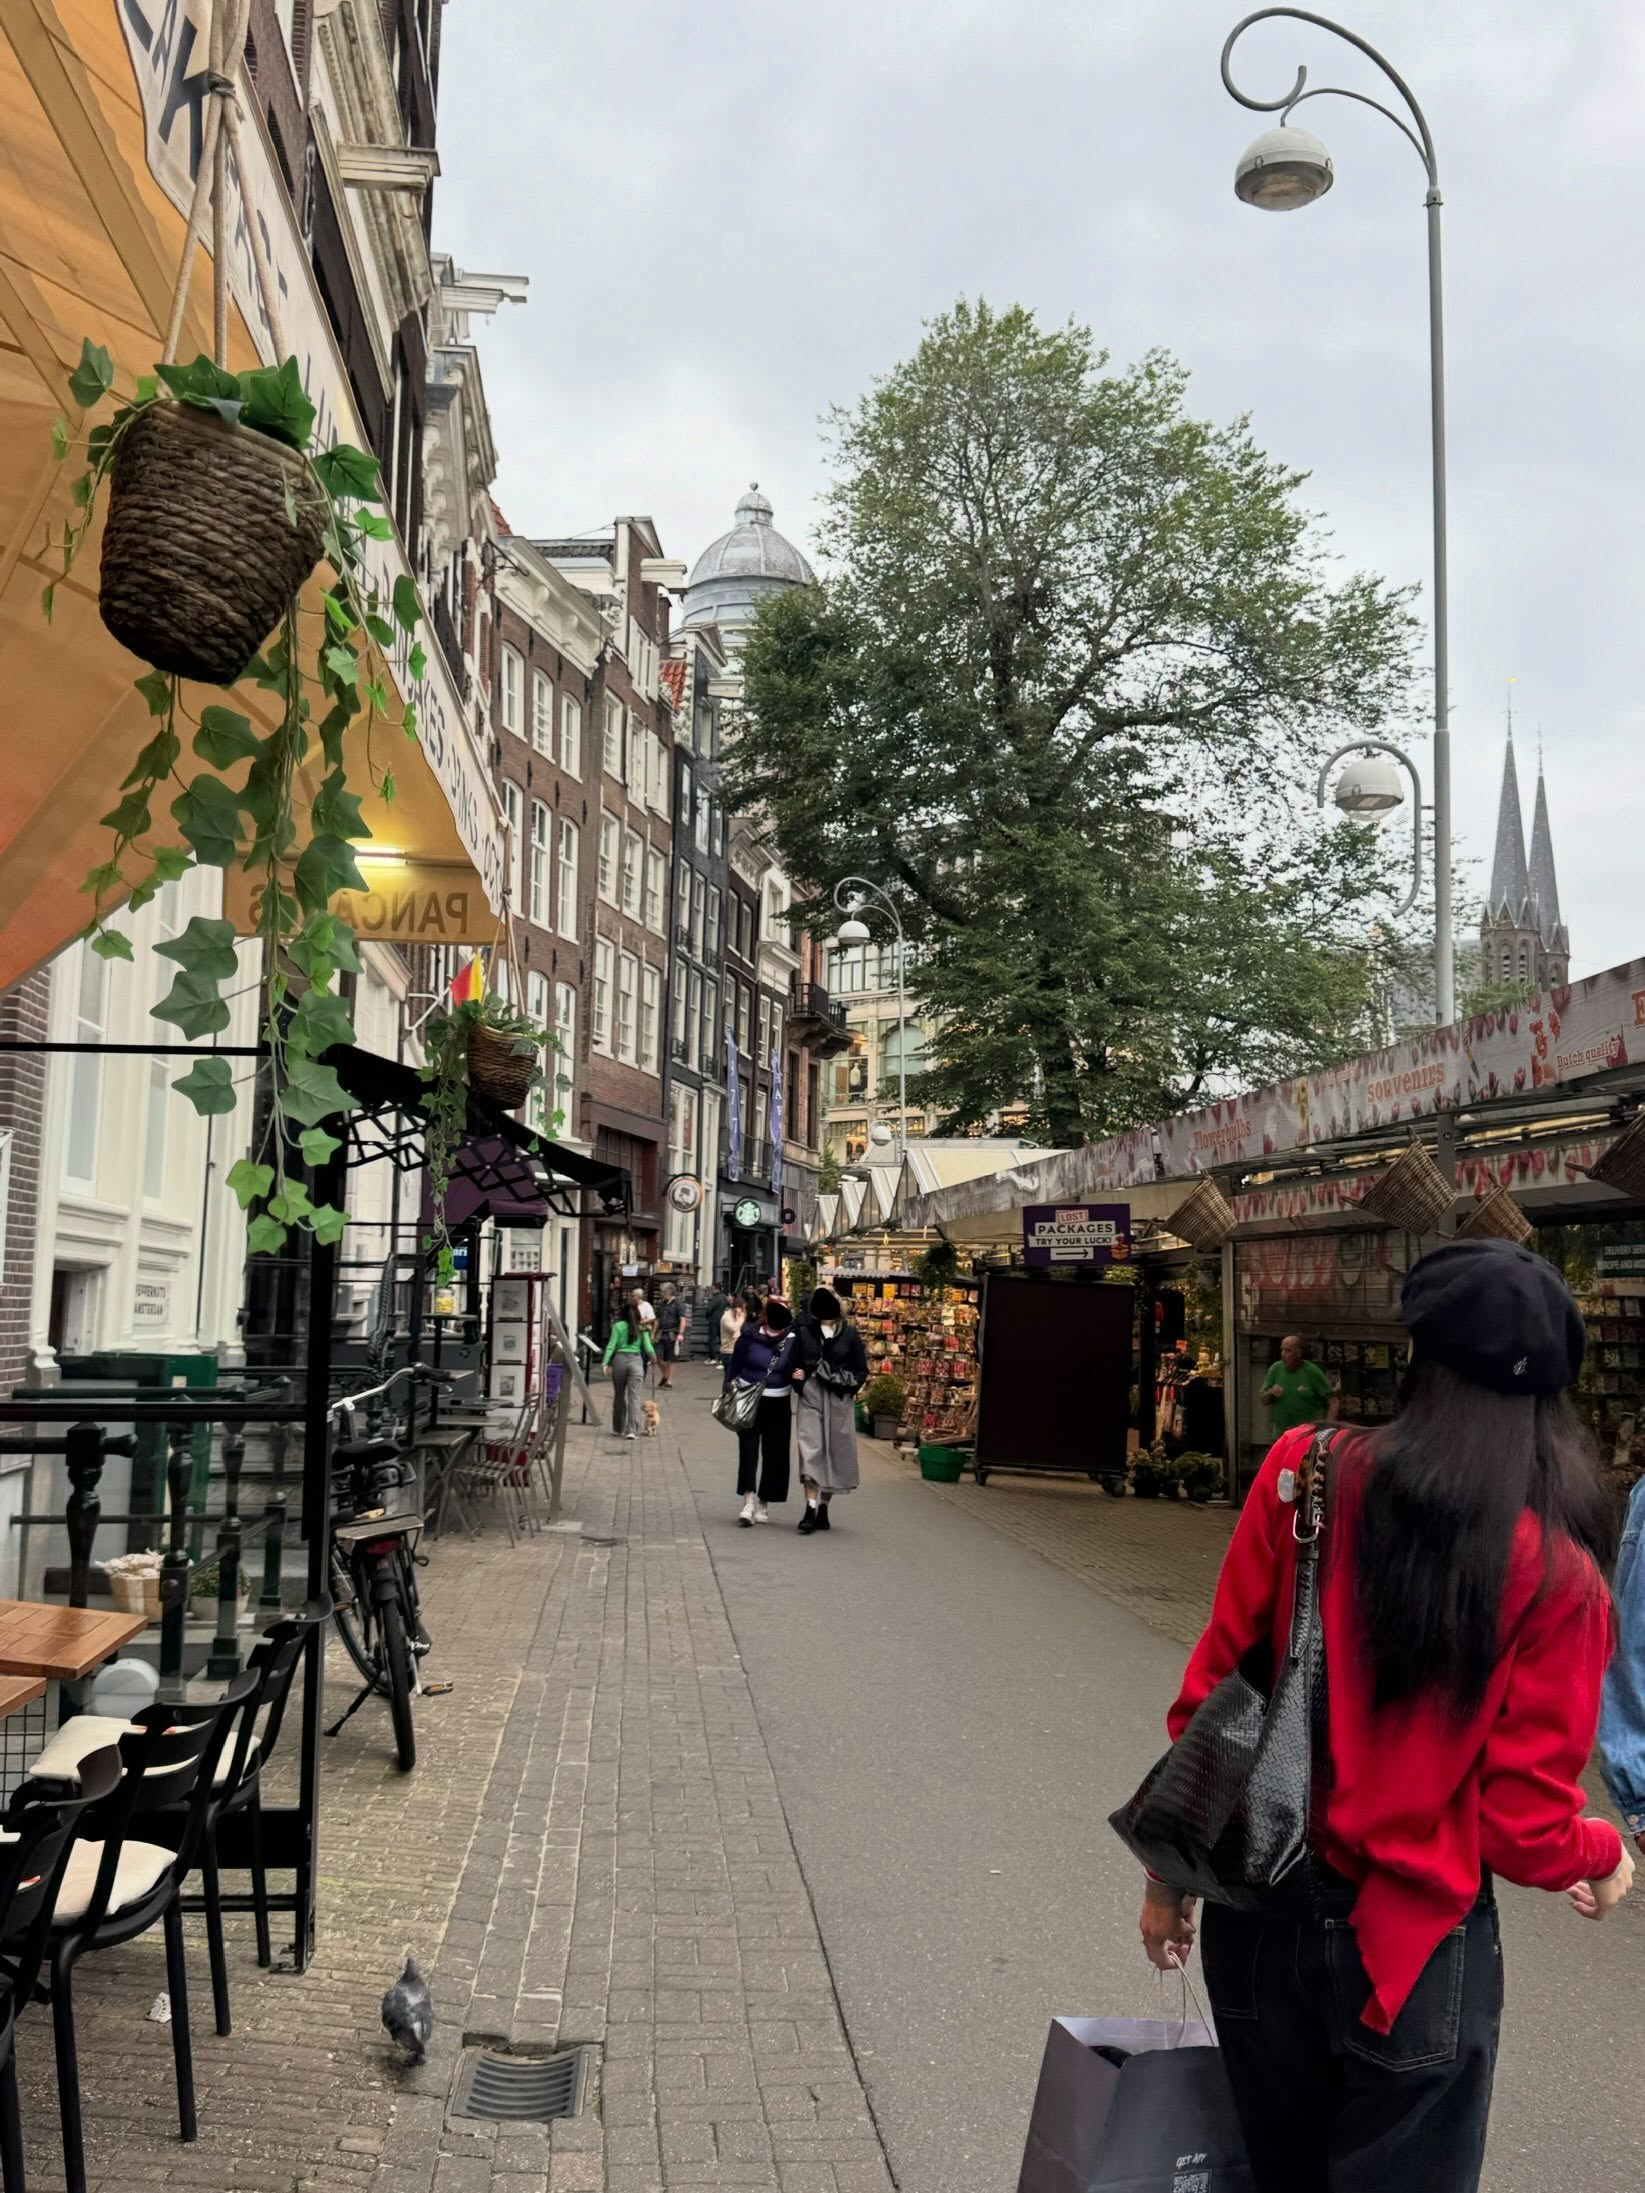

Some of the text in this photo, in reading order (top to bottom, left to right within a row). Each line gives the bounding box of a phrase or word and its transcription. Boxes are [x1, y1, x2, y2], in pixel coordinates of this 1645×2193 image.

[1556, 1040, 1620, 1070] Dutch quality
[1061, 1212, 1084, 1222] LOST
[1038, 1223, 1113, 1234] PACKAGES
[1035, 1236, 1112, 1246] TRY YOUR LUCK!
